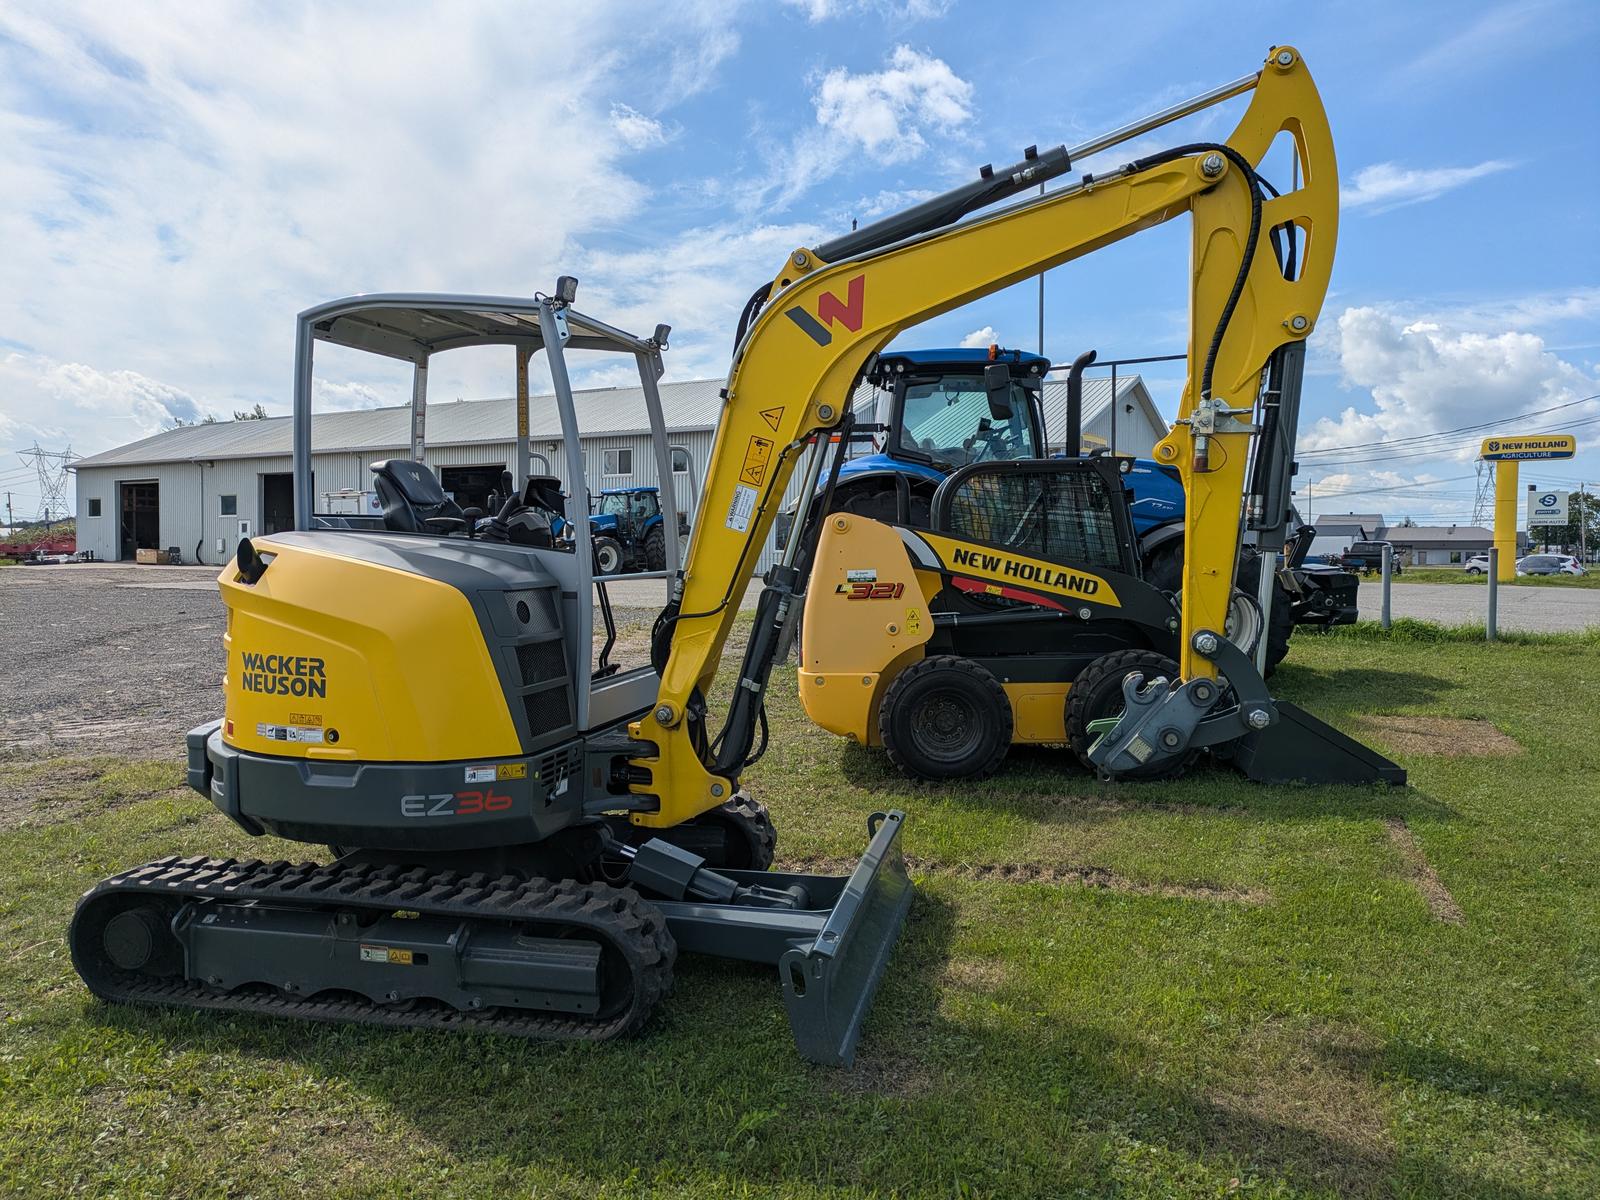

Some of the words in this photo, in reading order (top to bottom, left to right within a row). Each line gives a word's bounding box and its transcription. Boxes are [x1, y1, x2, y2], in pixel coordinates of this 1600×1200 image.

[1501, 451, 1552, 459] AGRICULTURE
[1502, 442, 1522, 450] NEW
[1524, 440, 1568, 449] HOLLAND
[953, 548, 1002, 572] NEW
[1004, 560, 1099, 595] HOLLAND
[242, 652, 326, 678] WACKER
[242, 672, 326, 698] NEUSON
[401, 788, 512, 817] EZ36
